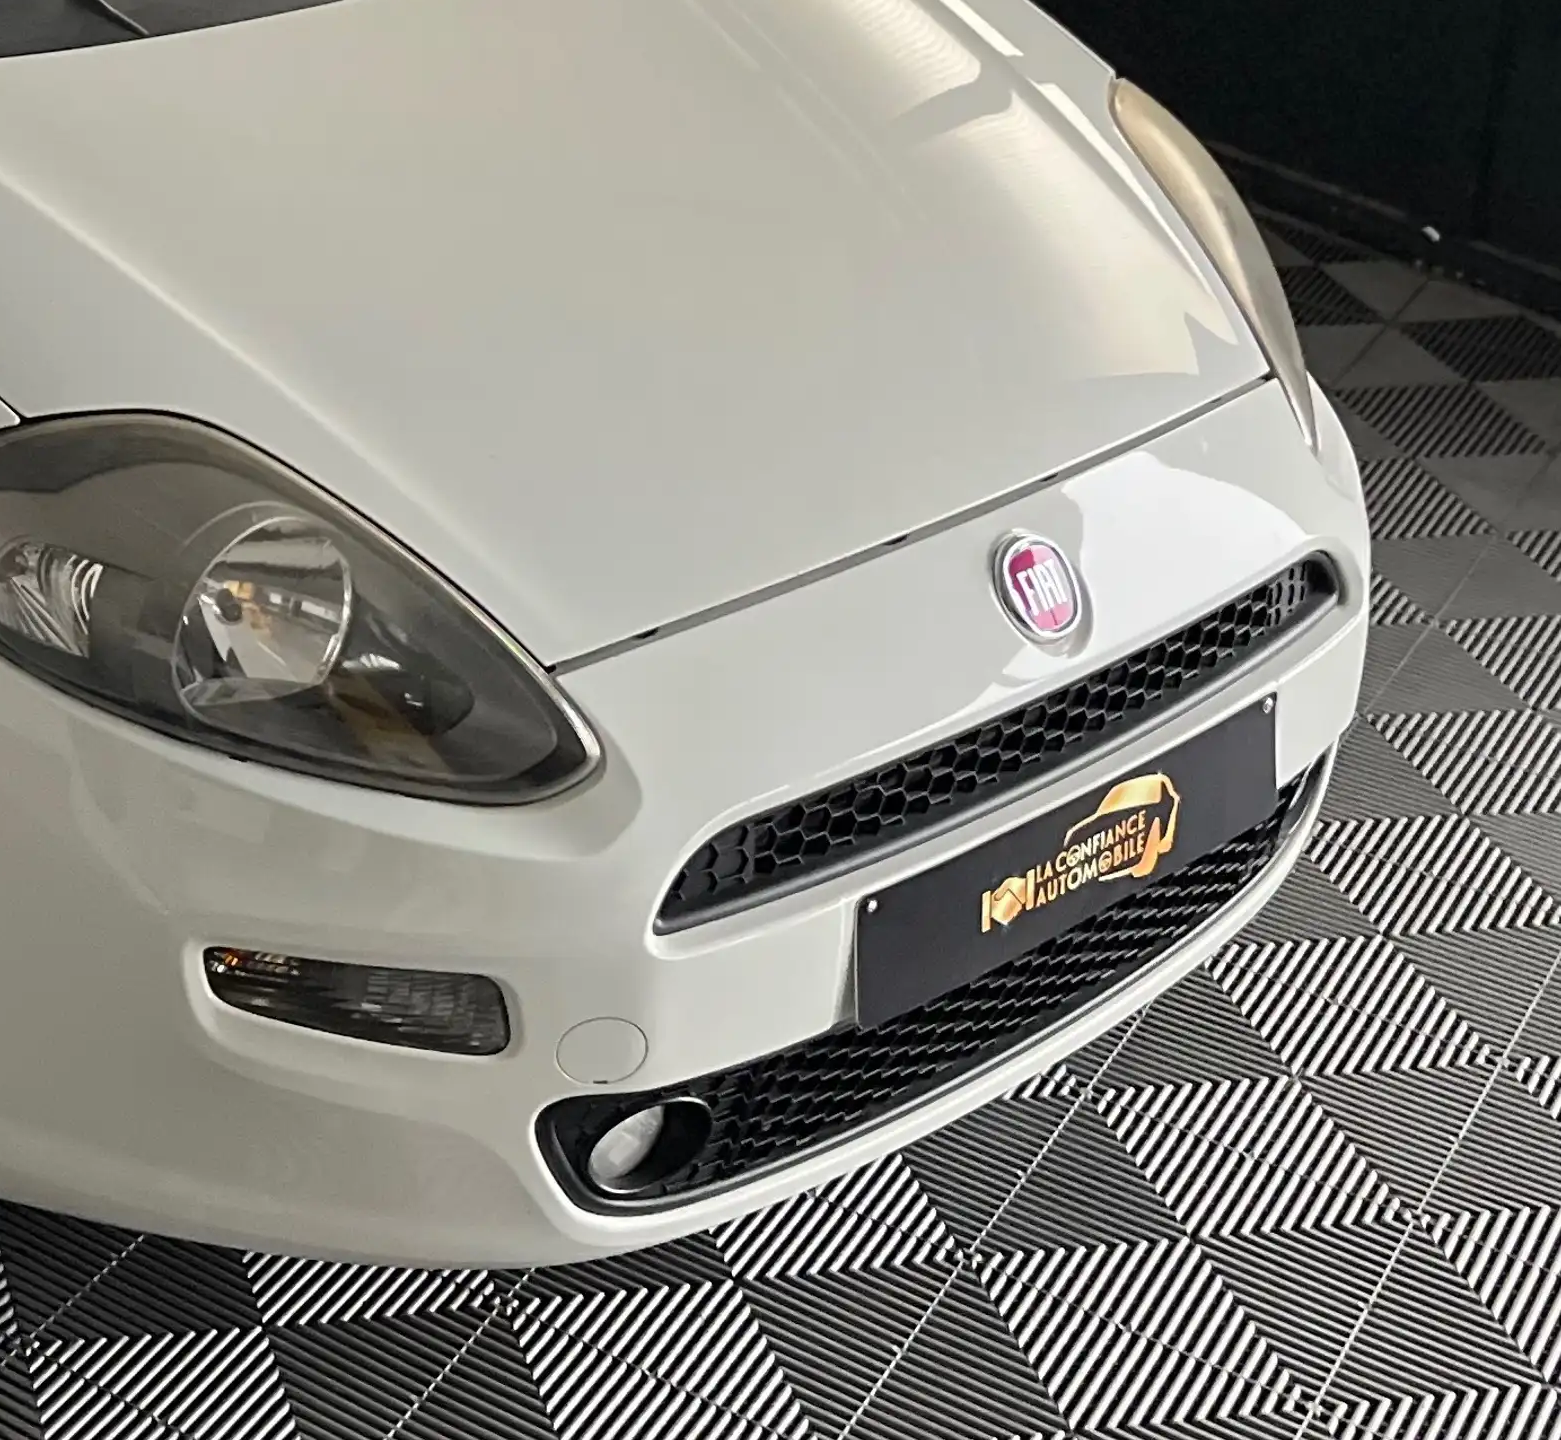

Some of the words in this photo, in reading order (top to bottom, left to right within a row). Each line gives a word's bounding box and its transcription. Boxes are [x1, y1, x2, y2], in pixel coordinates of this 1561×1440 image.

[1016, 558, 1068, 616] FIAT
[1036, 860, 1053, 883] LA
[1055, 810, 1146, 872] CONFIANCE
[1036, 832, 1145, 907] AUTOMOBILE
